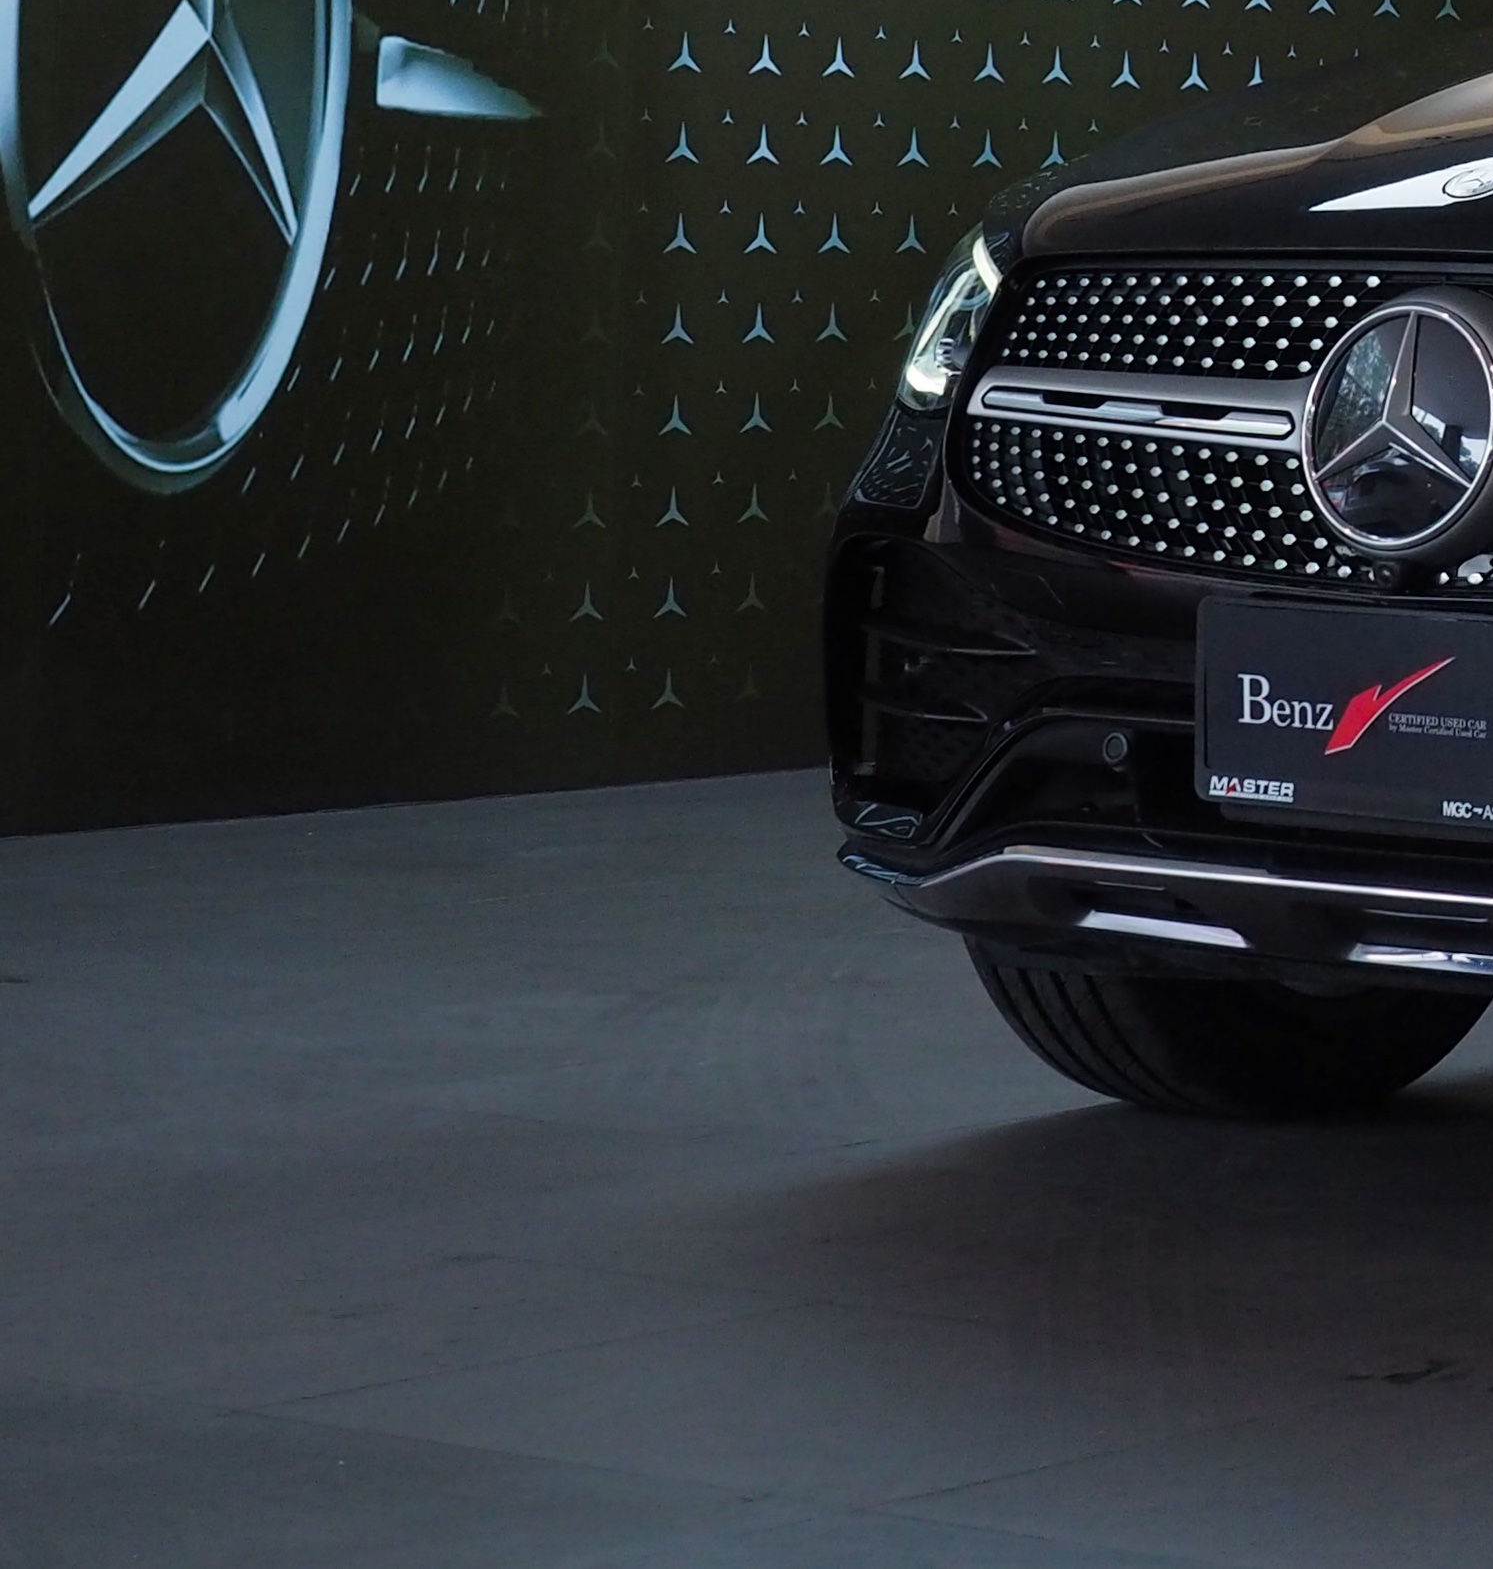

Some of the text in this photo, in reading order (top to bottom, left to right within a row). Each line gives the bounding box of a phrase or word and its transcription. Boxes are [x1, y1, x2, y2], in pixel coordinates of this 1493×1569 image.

[1237, 673, 1334, 730] Benz
[1388, 713, 1487, 730] CERTIFIED USED CAR
[1209, 775, 1294, 797] MASTER
